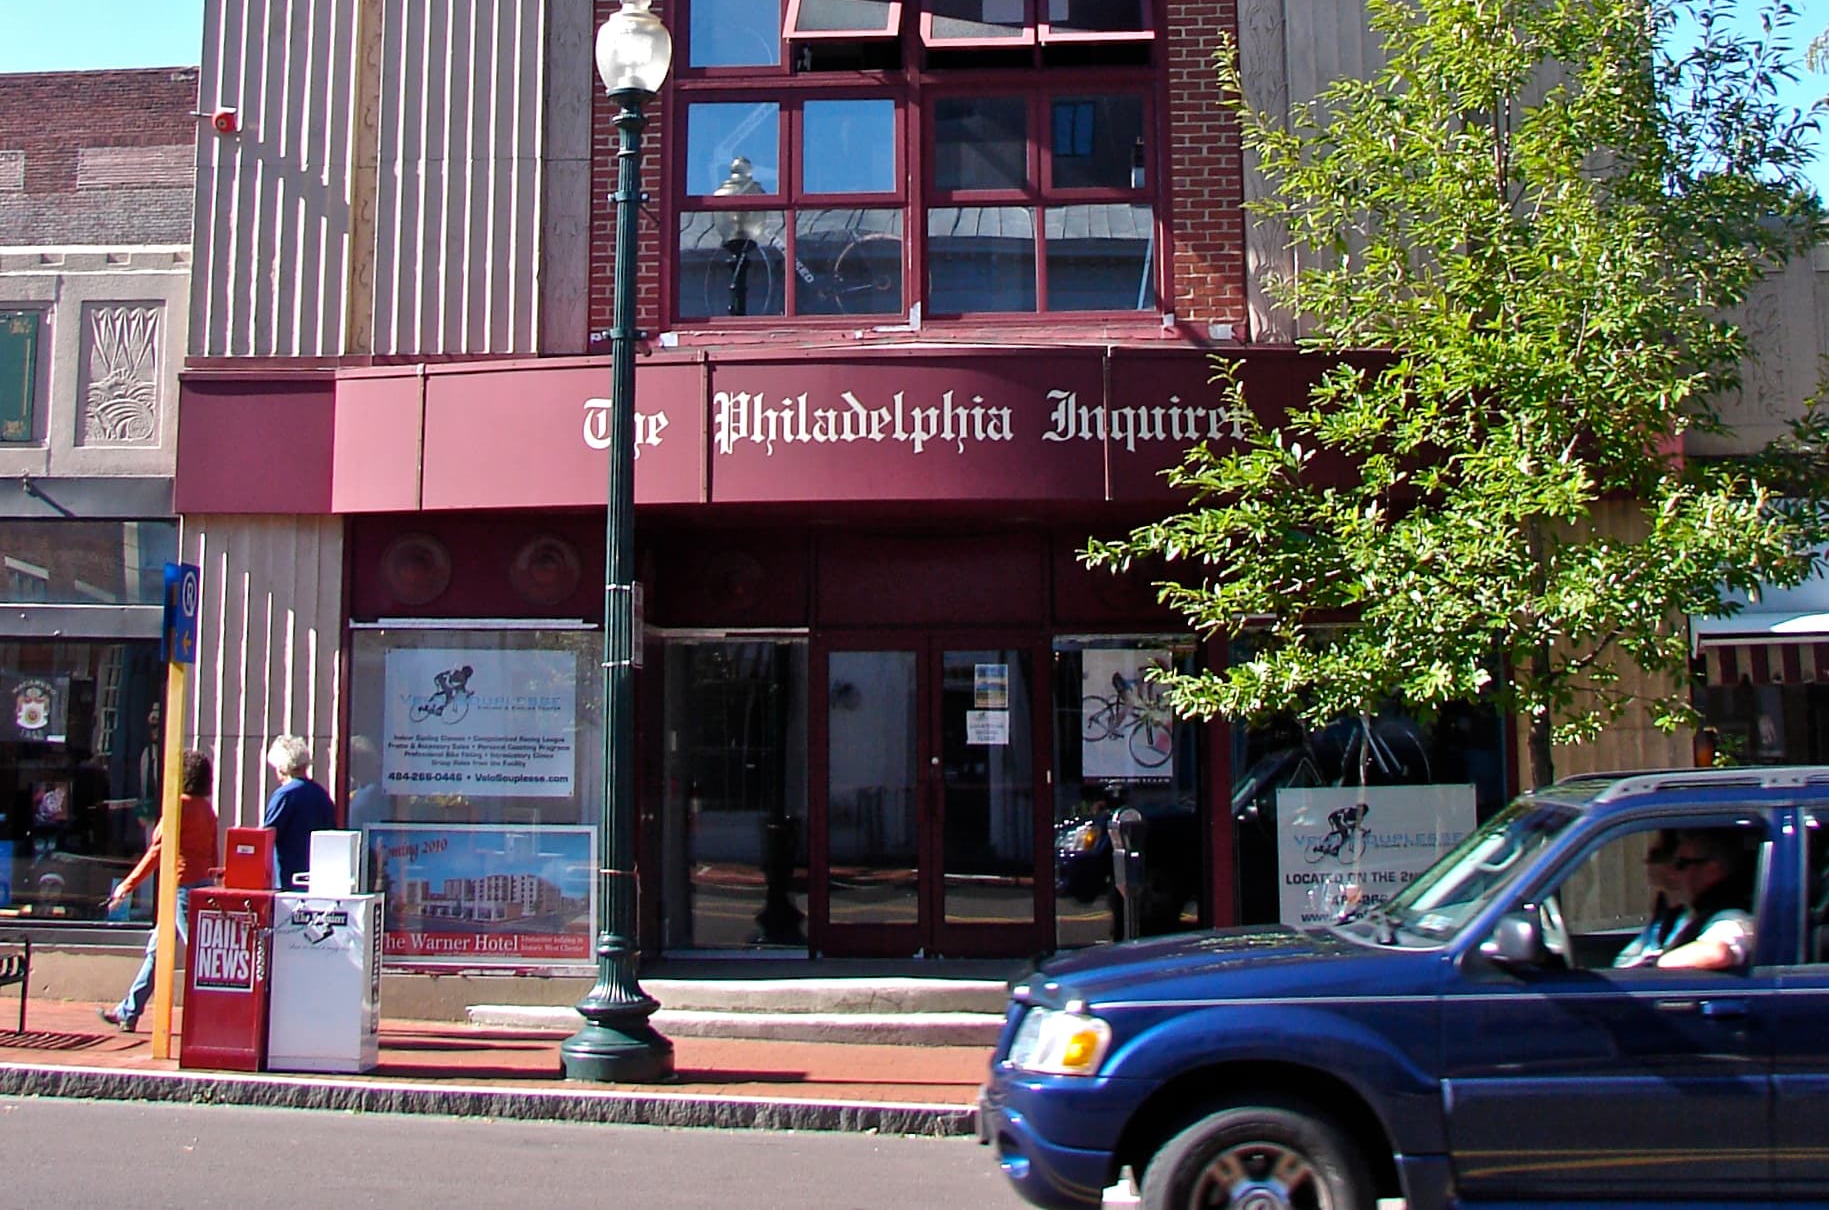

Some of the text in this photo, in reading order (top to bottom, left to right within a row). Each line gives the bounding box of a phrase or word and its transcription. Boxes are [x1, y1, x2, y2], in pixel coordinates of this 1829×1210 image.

[712, 390, 1014, 456] Philadelphia
[1041, 389, 1248, 453] Inquirer
[384, 843, 419, 863] oming
[1371, 870, 1396, 882] THE
[199, 917, 250, 950] DAILY
[383, 933, 406, 950] he
[410, 933, 470, 950] Warner
[474, 934, 518, 951] Hotel
[197, 947, 251, 980] NEWS
